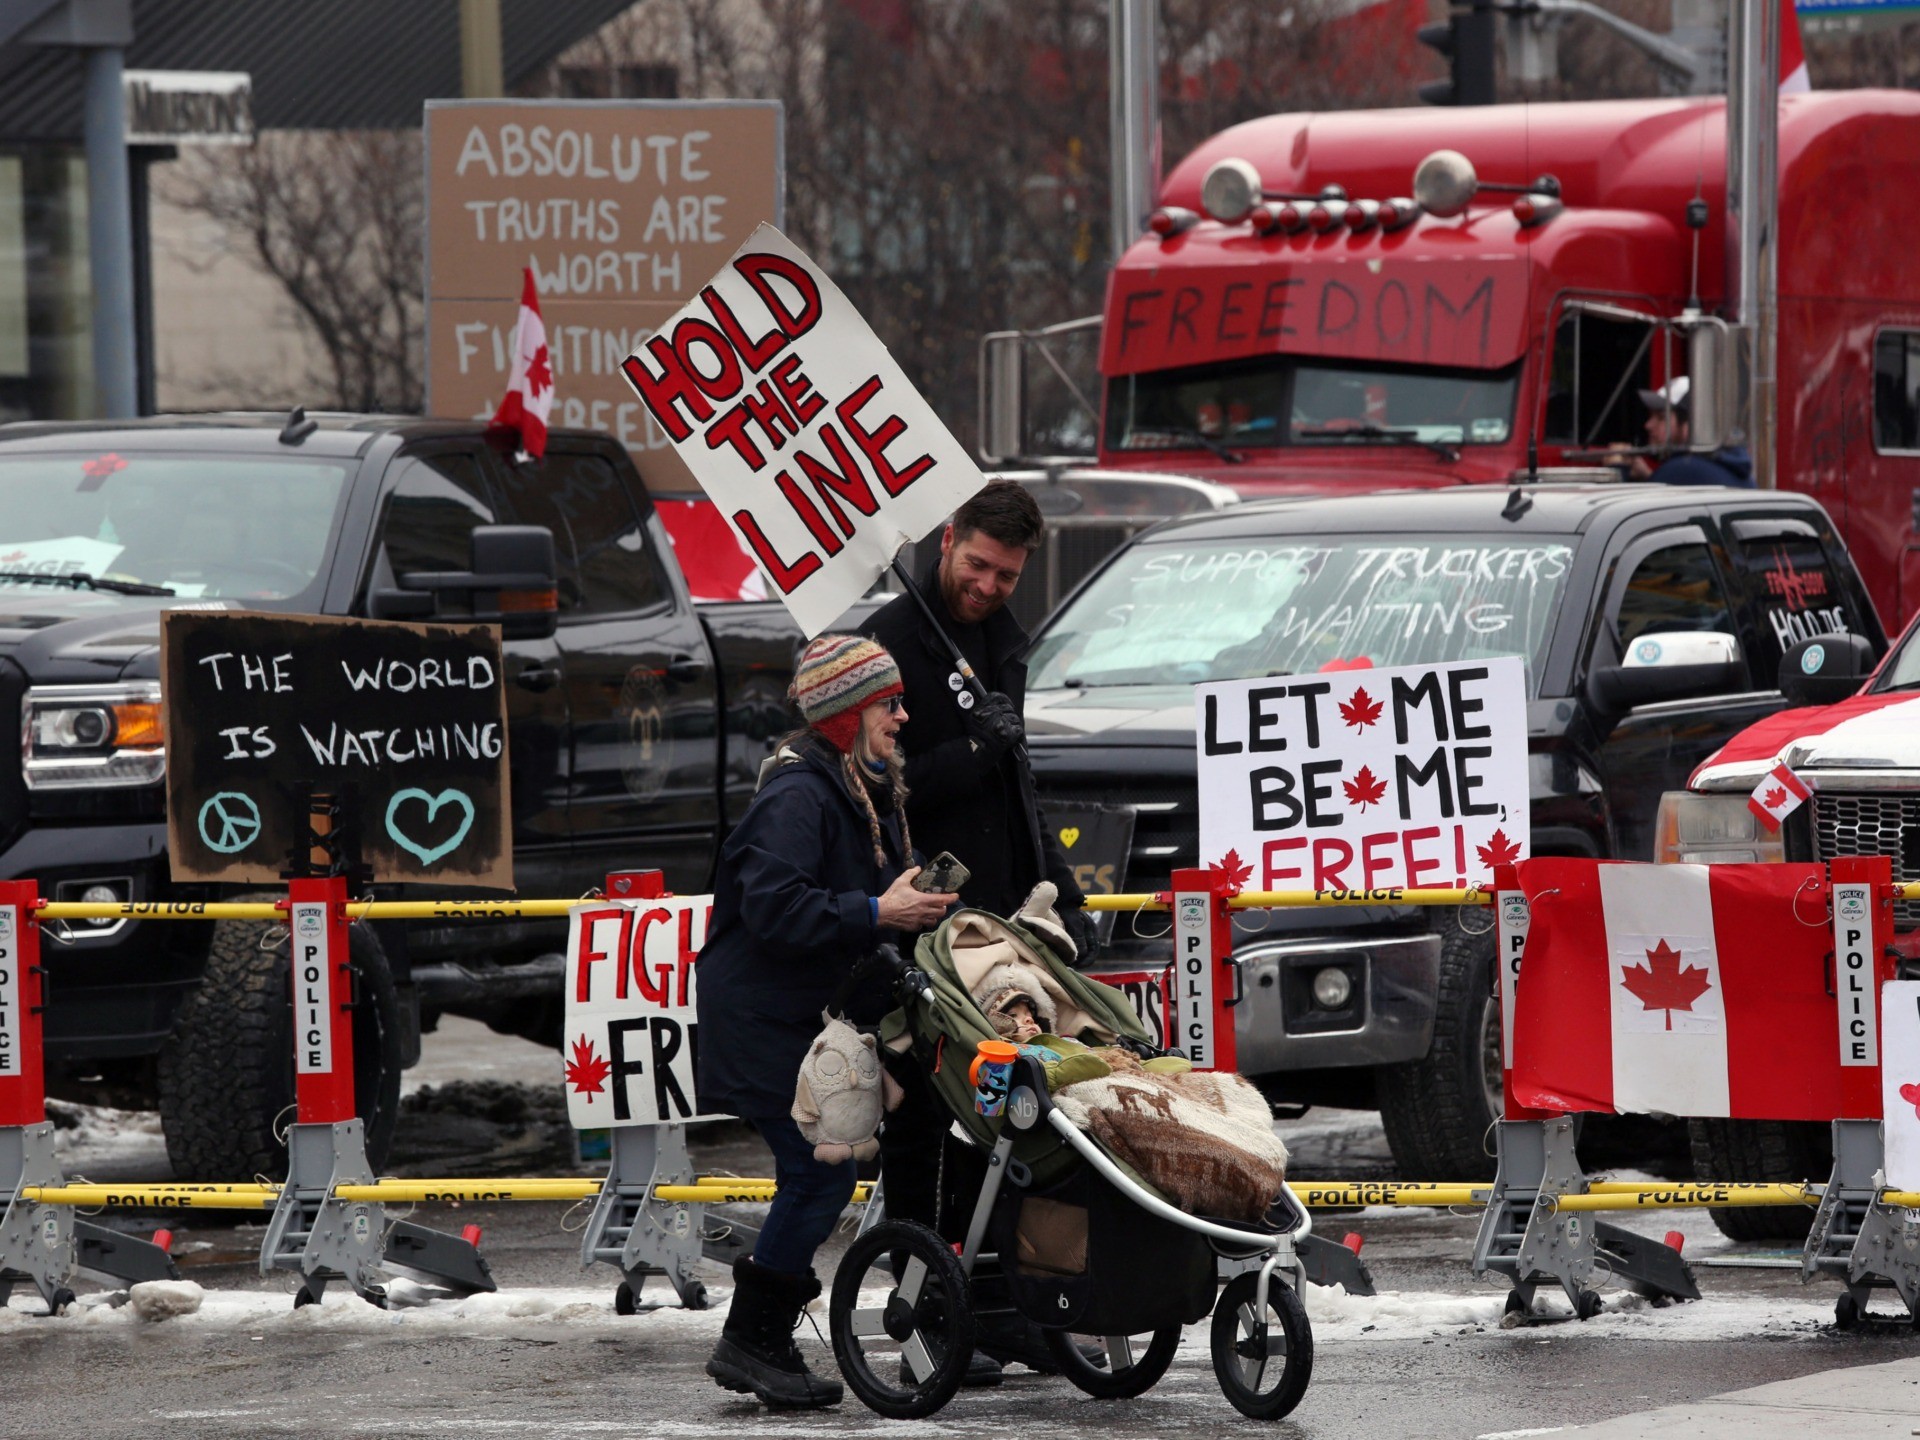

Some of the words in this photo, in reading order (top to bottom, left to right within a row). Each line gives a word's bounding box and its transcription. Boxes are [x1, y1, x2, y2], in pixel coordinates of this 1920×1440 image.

[456, 123, 712, 186] ABSOLUTE
[464, 197, 621, 243] TRUTHS
[643, 194, 727, 244] ARE
[529, 250, 681, 295] WORTH
[622, 253, 823, 443] HOLD
[1119, 276, 1496, 366] FREEDOM
[549, 397, 668, 453] REED
[704, 352, 829, 473] THE
[732, 375, 937, 595] LINE
[1131, 546, 1343, 585] SUPPORT
[1349, 546, 1573, 587] TRUCKERS
[1281, 601, 1513, 643] WAITING
[199, 652, 293, 693] THE
[341, 656, 494, 693] WORLD
[1205, 682, 1331, 756] LET
[1391, 667, 1491, 744] ME
[219, 726, 276, 760] IS
[300, 721, 502, 766] WATCHING
[1249, 759, 1344, 831] BE
[1395, 745, 1507, 822] ME,
[1262, 824, 1467, 891] FREE!
[121, 903, 205, 914] POLICE
[1315, 890, 1402, 900] POLICE
[304, 946, 322, 1067] POLICE
[1186, 936, 1203, 1061] POLICE
[1846, 930, 1866, 1059] POLICE
[107, 1195, 192, 1206] POLICE
[1309, 1191, 1397, 1205] POLICE
[1638, 1191, 1728, 1204] POLICE
